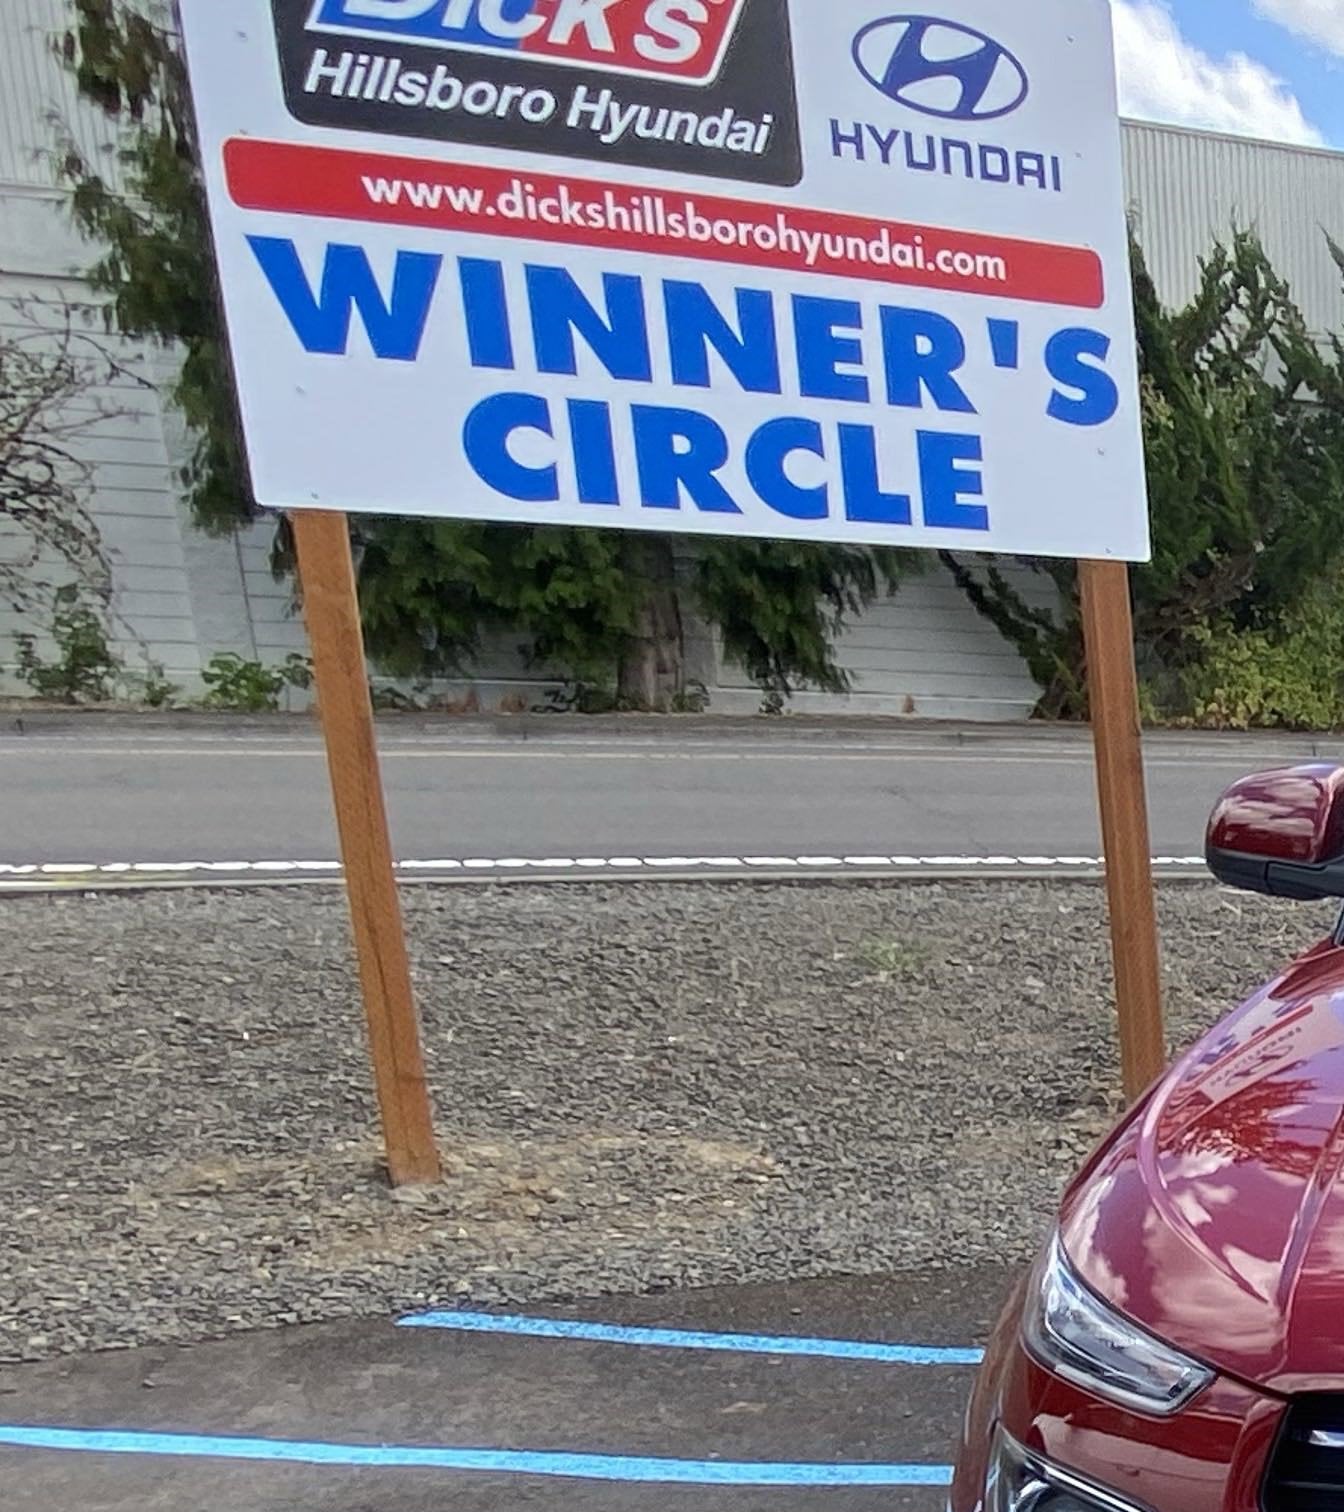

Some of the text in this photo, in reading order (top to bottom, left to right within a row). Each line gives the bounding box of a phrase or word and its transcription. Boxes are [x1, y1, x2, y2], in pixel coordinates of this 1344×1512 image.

[342, 0, 708, 64] cks
[304, 48, 774, 155] Hillsboro Hyundai
[829, 118, 1062, 192] HYUNDAI
[361, 173, 1007, 282] www.dickshillsborohyundai.com
[245, 234, 1120, 427] WINNER'S
[463, 391, 990, 532] CIRCLE
